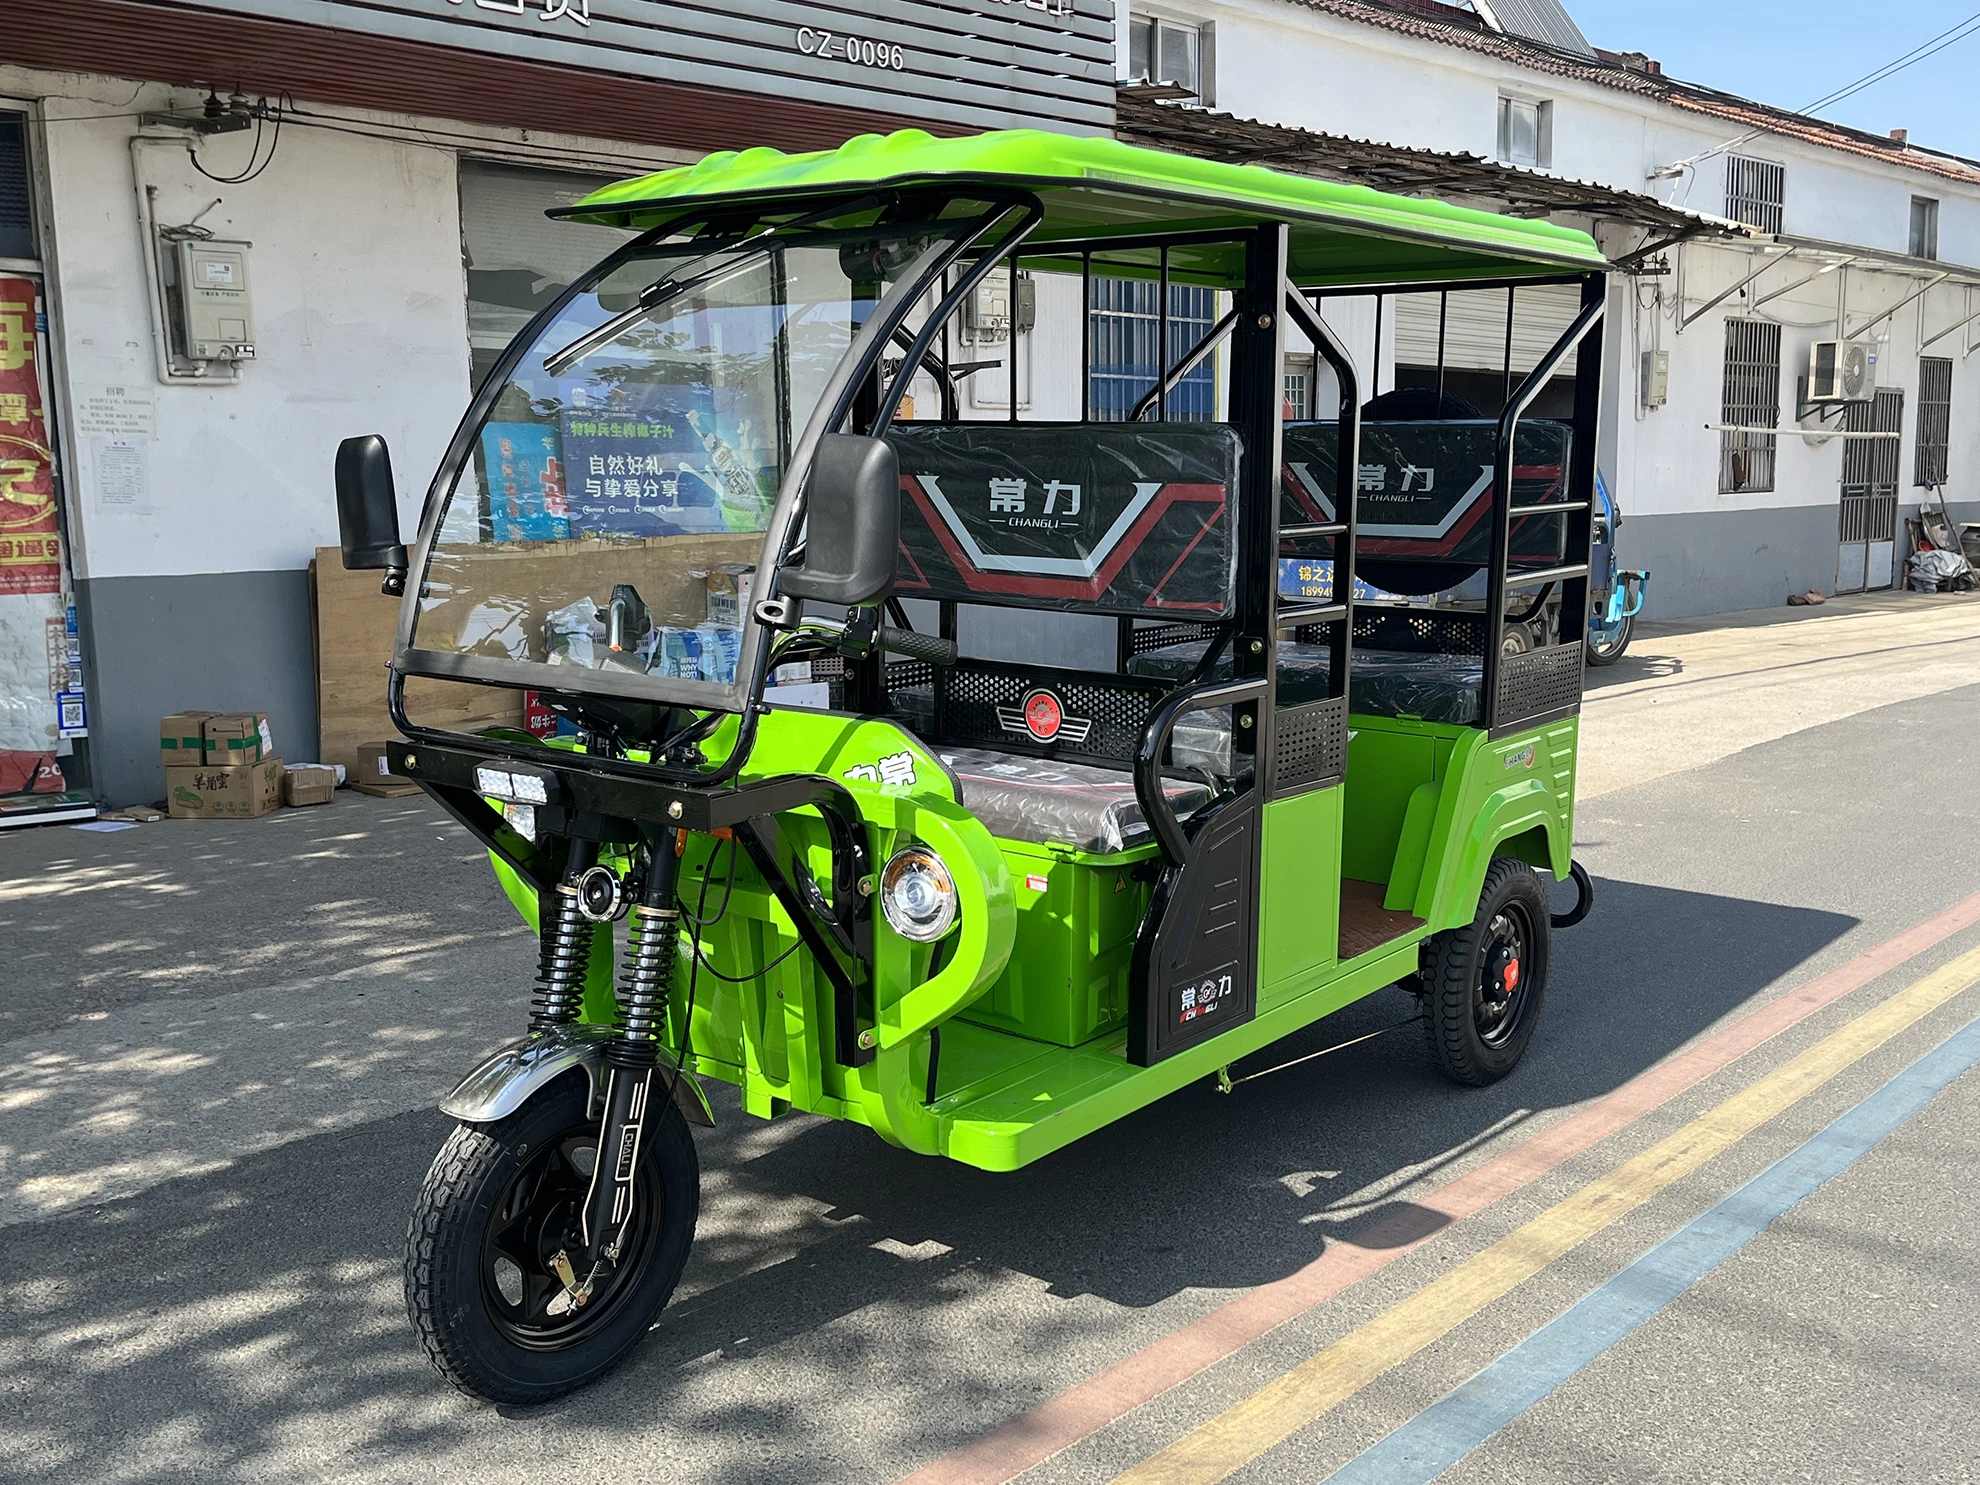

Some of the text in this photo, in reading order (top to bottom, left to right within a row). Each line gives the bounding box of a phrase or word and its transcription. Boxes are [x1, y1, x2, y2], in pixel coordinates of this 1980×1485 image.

[796, 26, 904, 70] CZ-0096
[589, 455, 663, 476] 自然好礼
[584, 478, 679, 498] 与挚爱分享
[1357, 464, 1434, 491] 常力
[988, 477, 1081, 515] 常力
[1369, 494, 1415, 502] CHANGLI
[1008, 517, 1059, 528] CHANGLI
